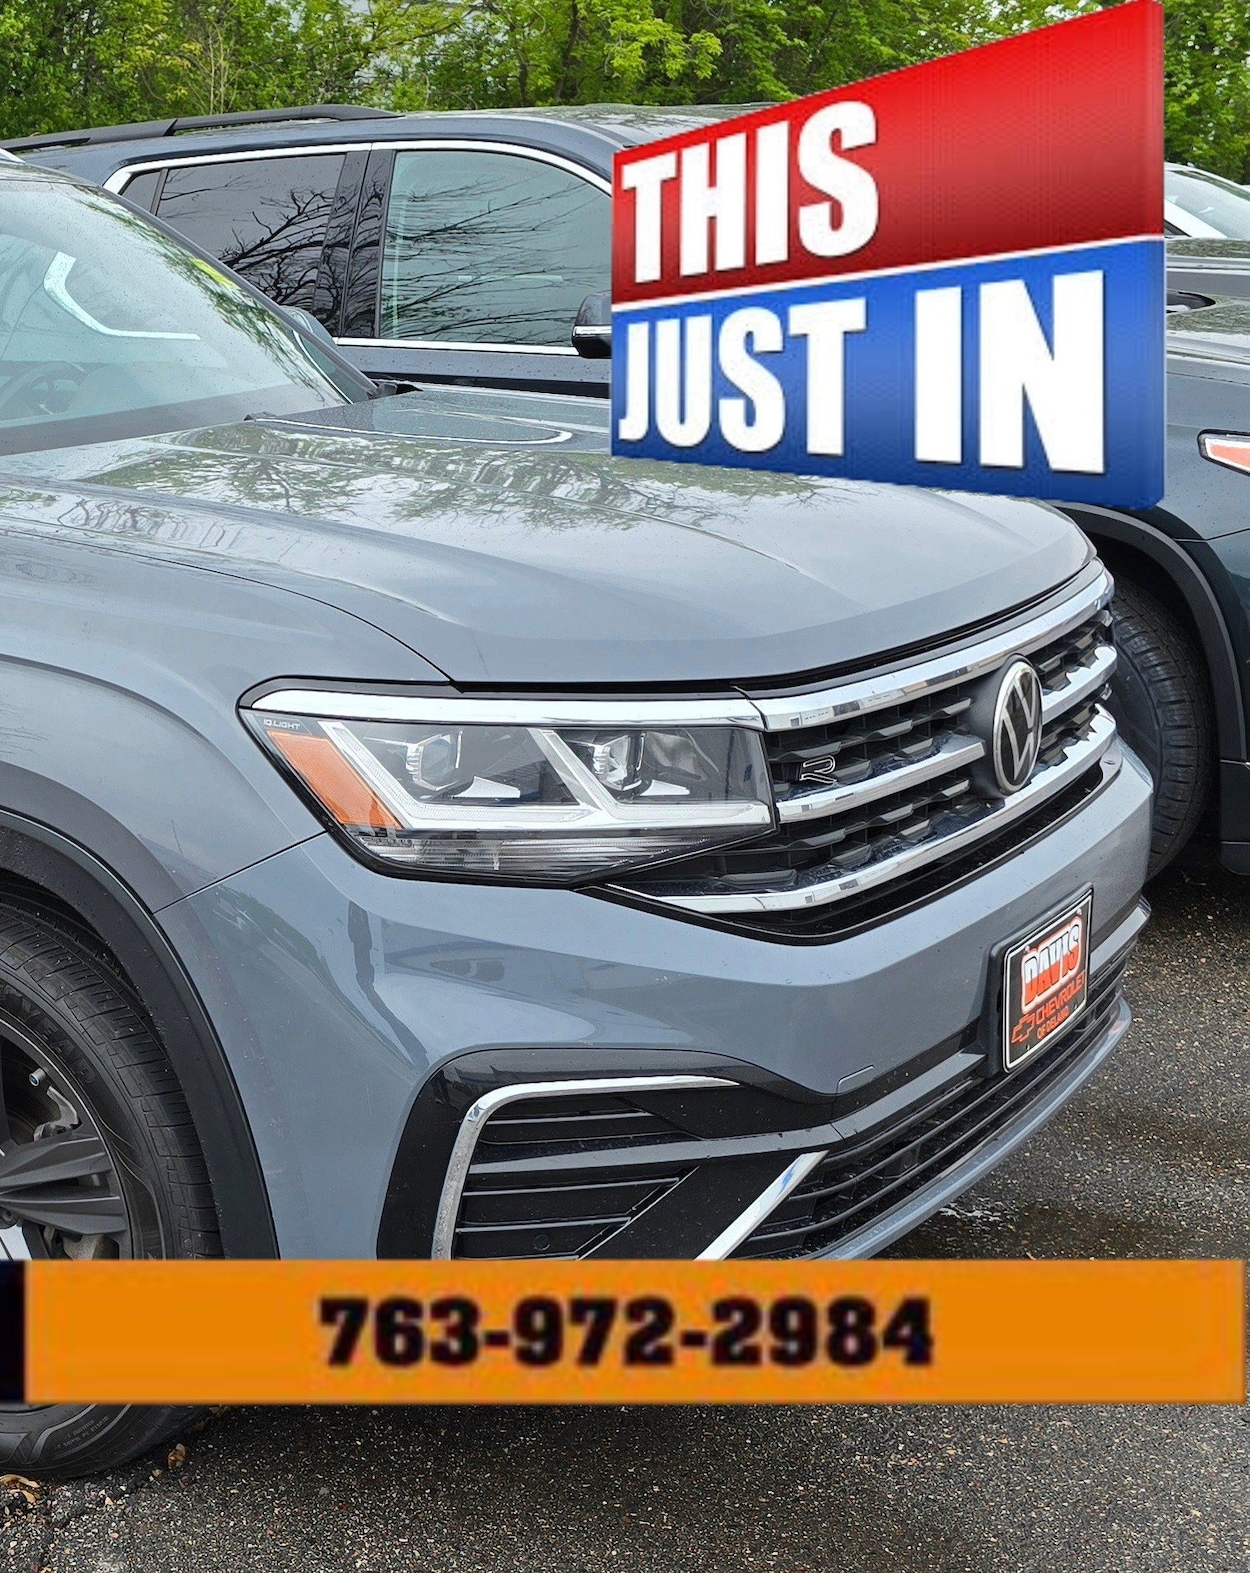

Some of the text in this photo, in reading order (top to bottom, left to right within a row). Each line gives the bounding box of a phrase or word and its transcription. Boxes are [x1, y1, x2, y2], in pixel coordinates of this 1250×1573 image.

[1023, 922, 1081, 1008] DAVIS
[1036, 969, 1087, 1026] CHEVROLET
[1036, 1024, 1046, 1040] OF
